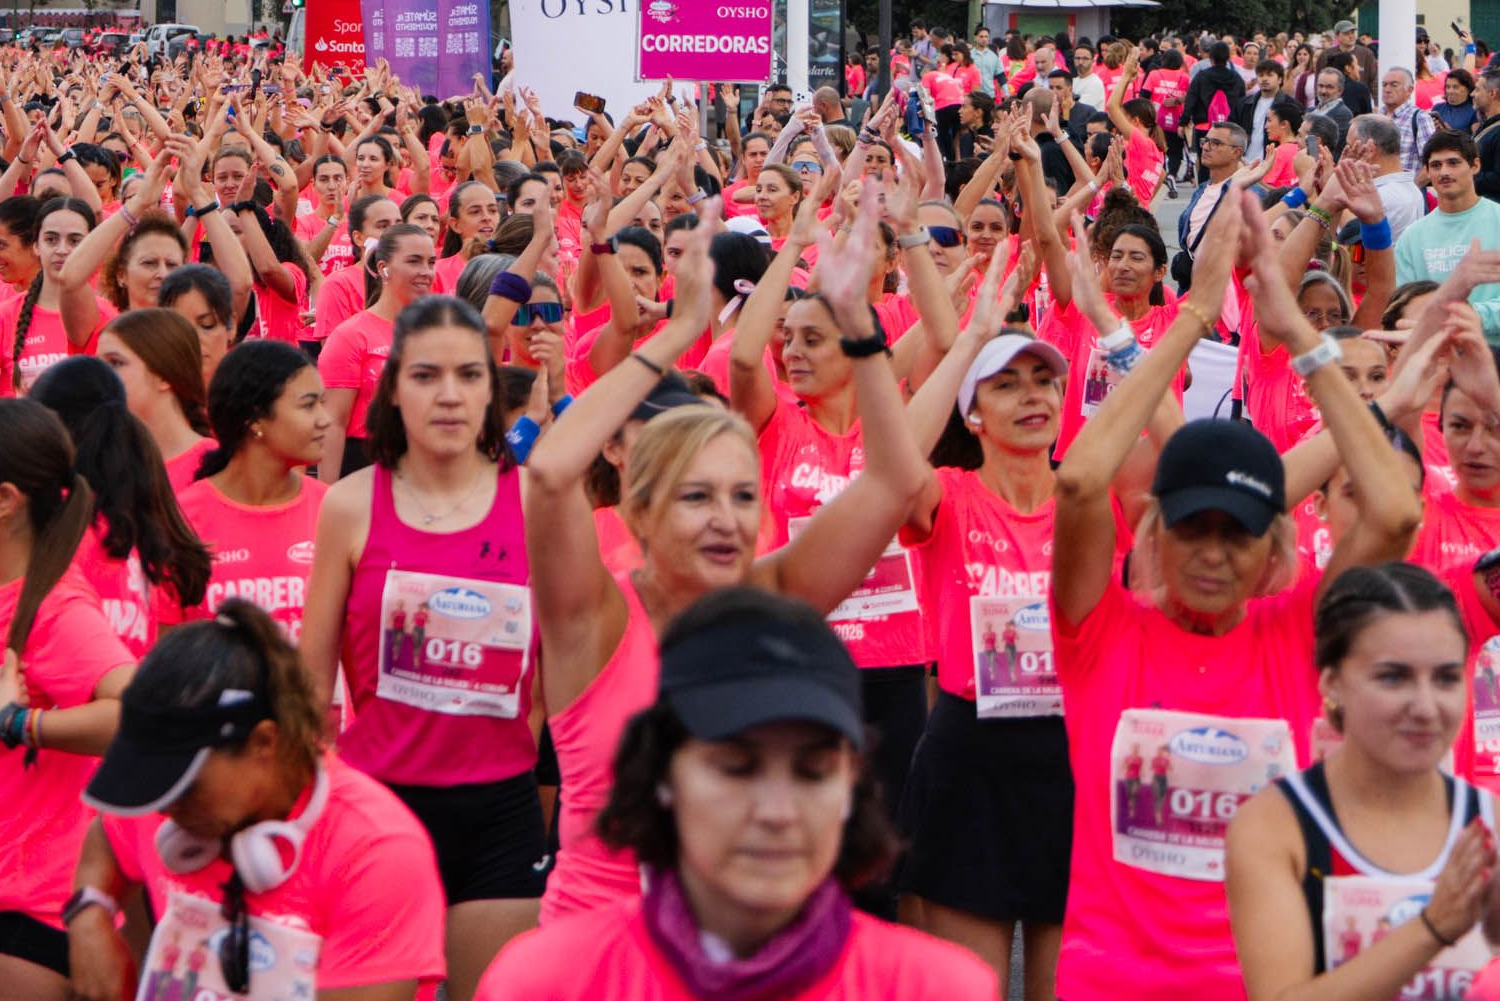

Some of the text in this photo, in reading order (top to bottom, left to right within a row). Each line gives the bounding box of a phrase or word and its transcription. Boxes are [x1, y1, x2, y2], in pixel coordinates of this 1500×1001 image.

[717, 6, 768, 19] OYSHO
[333, 19, 363, 34] Spor
[329, 40, 365, 53] Santa
[642, 34, 769, 54] CORREDORAS
[217, 548, 250, 564] SHO
[207, 577, 305, 613] CARRER
[426, 638, 483, 666] 016
[1020, 651, 1053, 672] 01
[1170, 788, 1238, 819] 016
